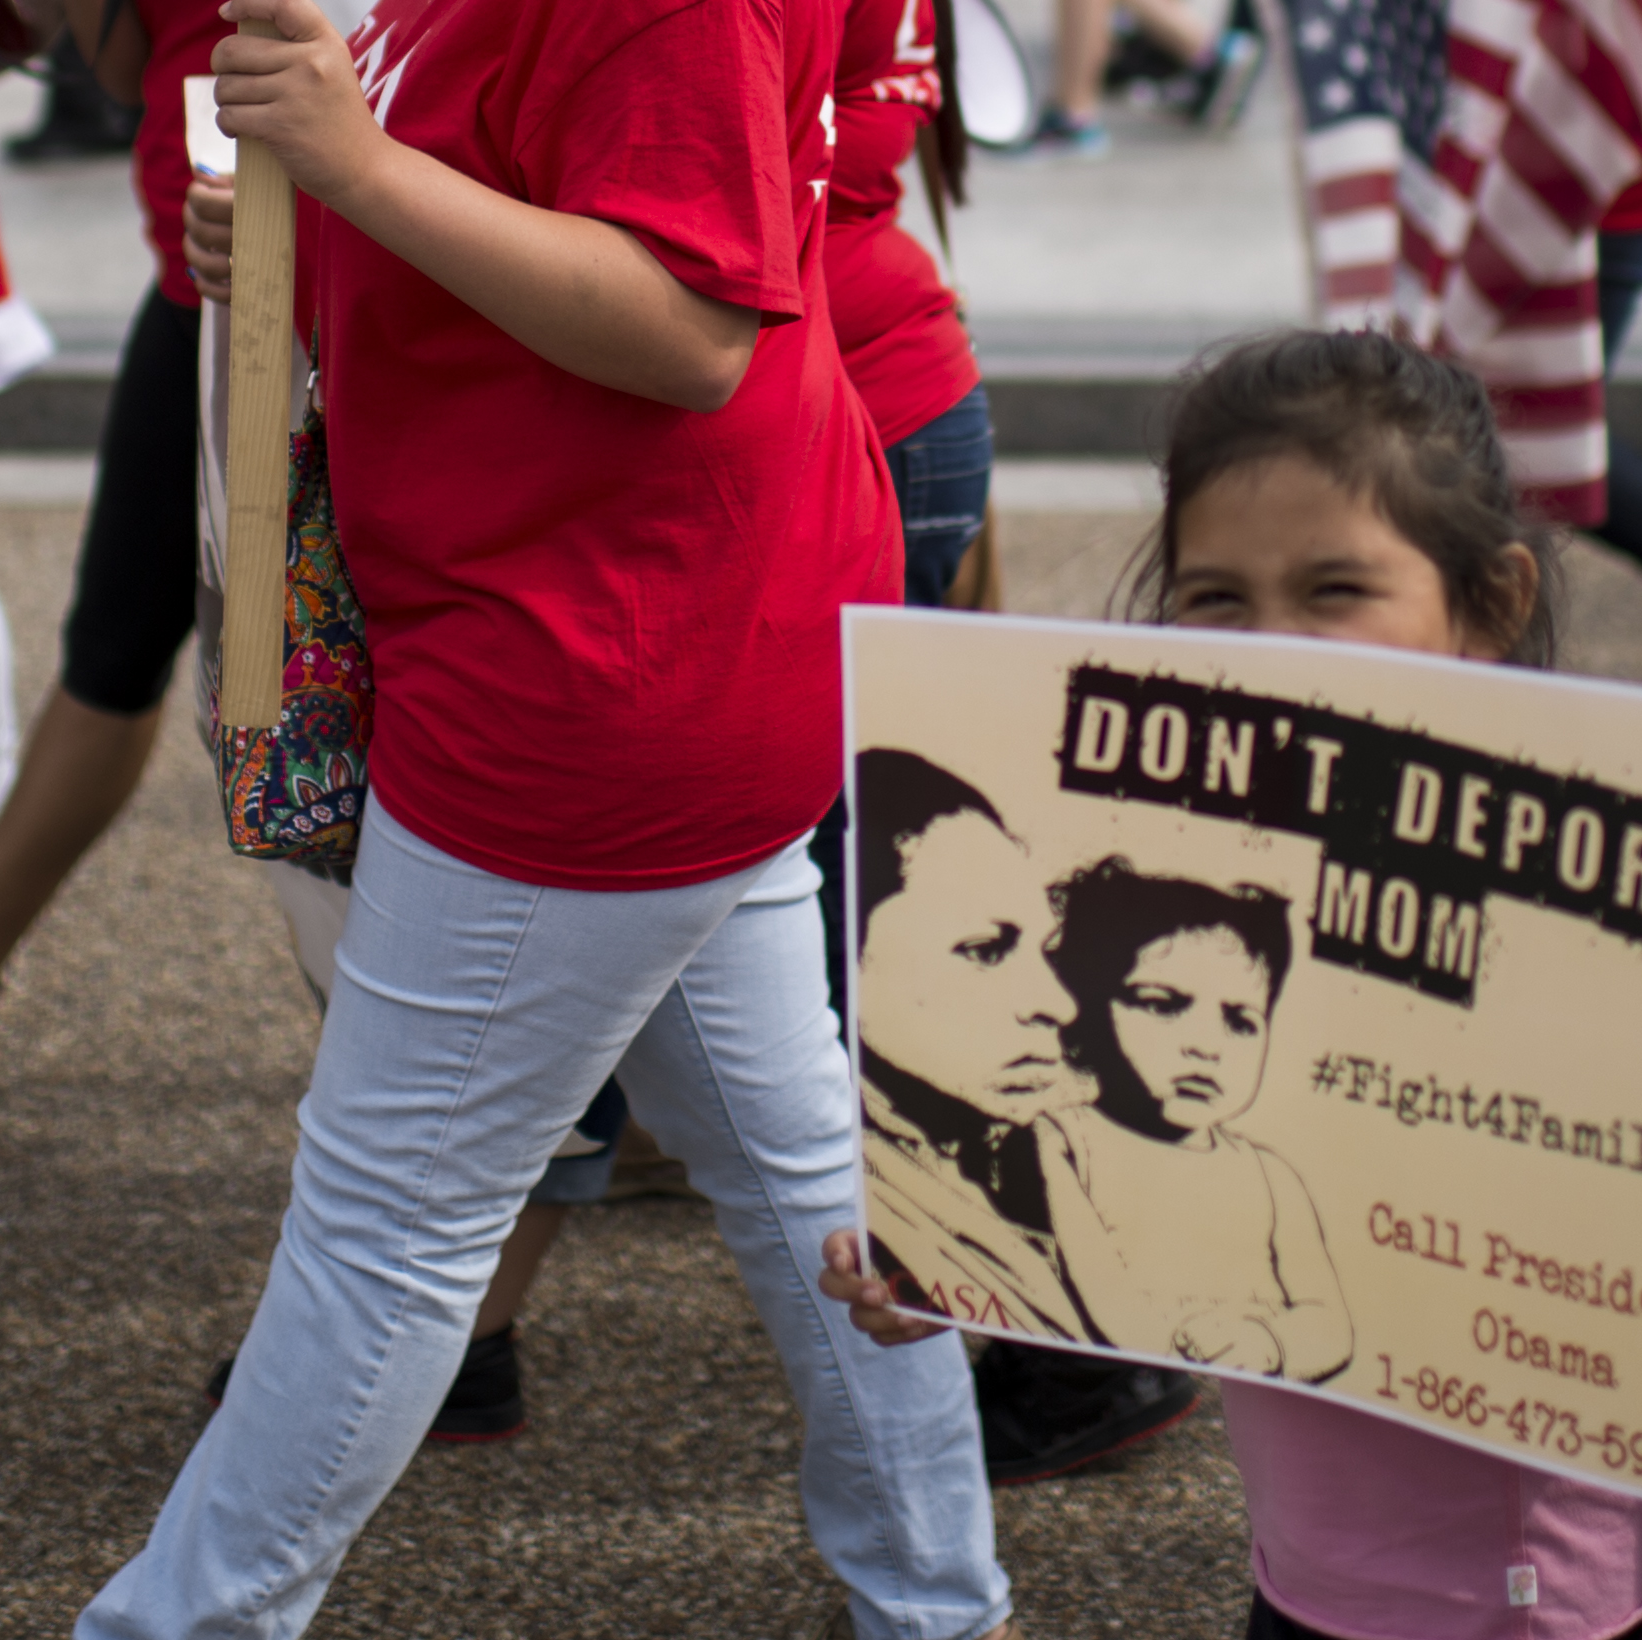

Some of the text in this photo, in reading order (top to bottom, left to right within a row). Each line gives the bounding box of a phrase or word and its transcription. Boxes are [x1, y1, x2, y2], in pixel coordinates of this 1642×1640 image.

[1073, 695, 1343, 817] DON'T
[1316, 862, 1482, 981] MOM
[1368, 1201, 1466, 1270] Call
[1472, 1307, 1621, 1390] Obama
